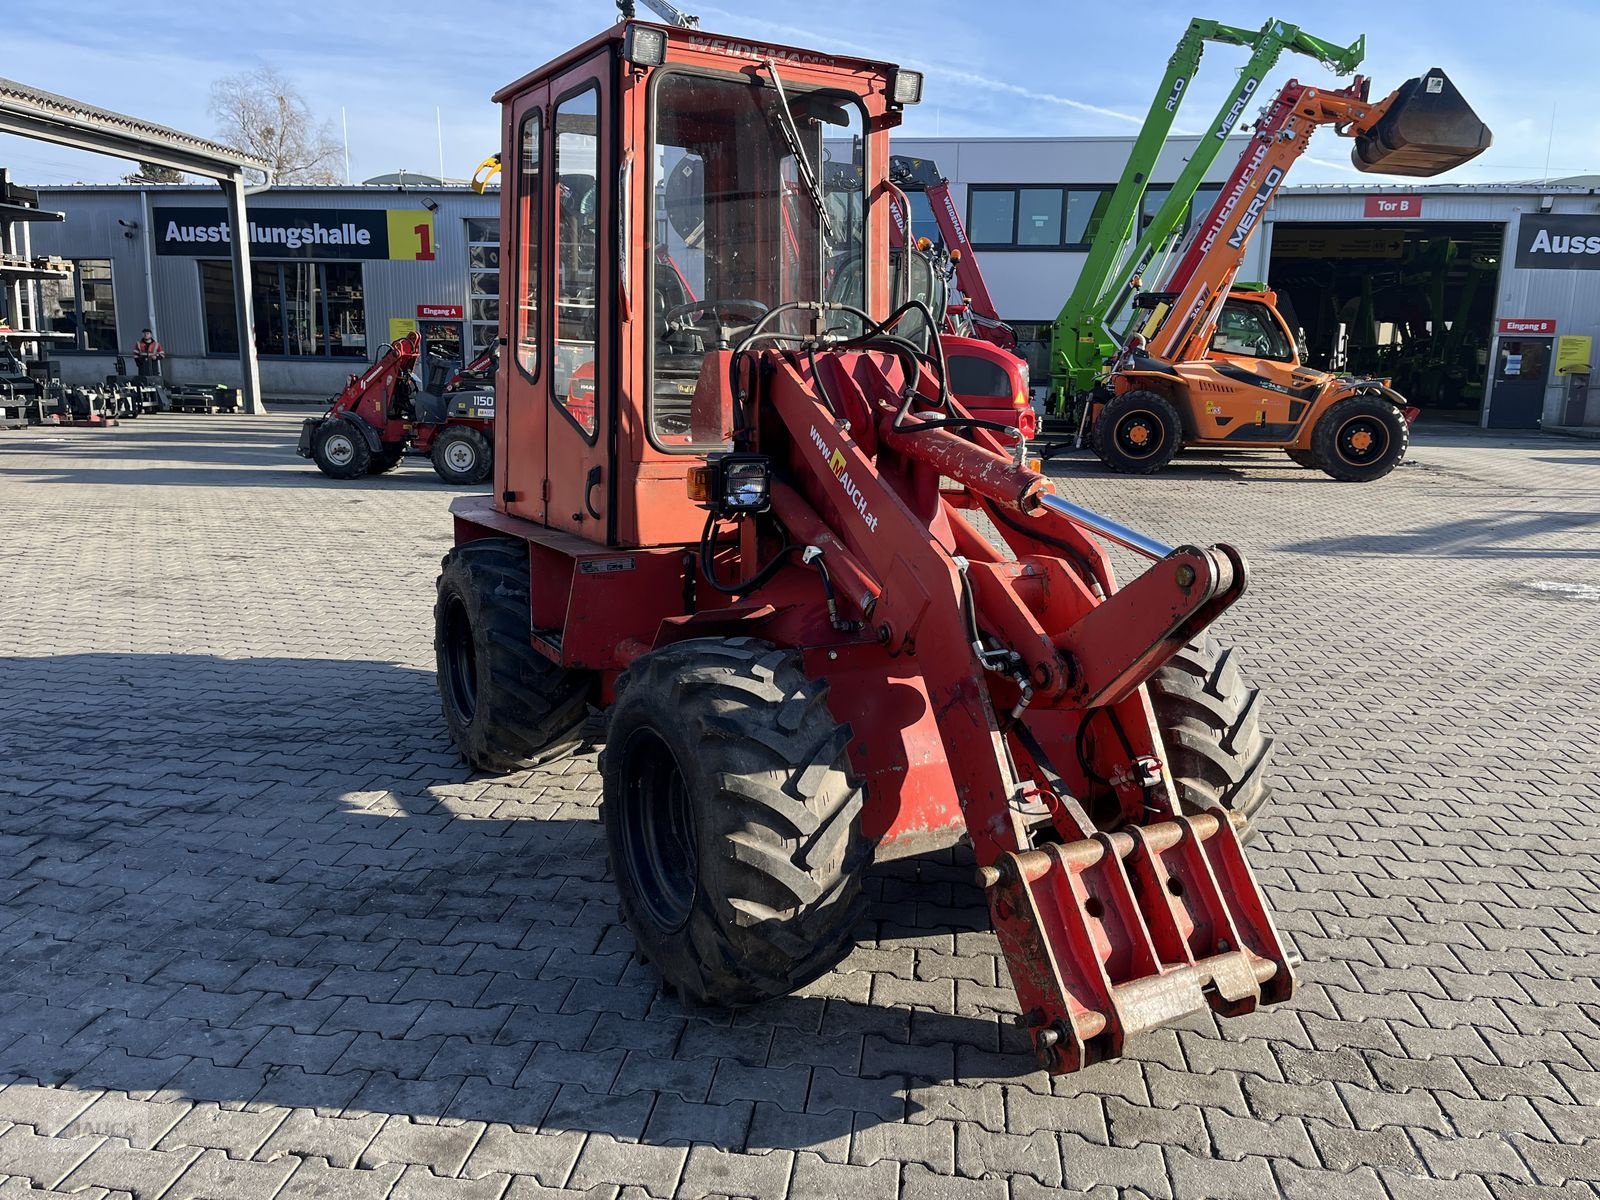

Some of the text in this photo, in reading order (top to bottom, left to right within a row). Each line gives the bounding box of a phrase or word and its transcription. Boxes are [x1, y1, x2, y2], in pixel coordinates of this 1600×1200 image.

[688, 35, 834, 70] WEIDEMANN
[1215, 78, 1258, 139] MERLO
[943, 196, 966, 244] WEIDEMANN
[1228, 168, 1282, 247] MERLO
[1378, 200, 1409, 211] Tor B
[165, 220, 435, 261] Ausstlungshalle 1
[1529, 229, 1600, 255] Auss
[423, 307, 456, 316] Eingang A
[1506, 322, 1548, 331] Eingang B
[473, 395, 494, 407] 1150
[809, 424, 878, 533] www.MAUCH.at
